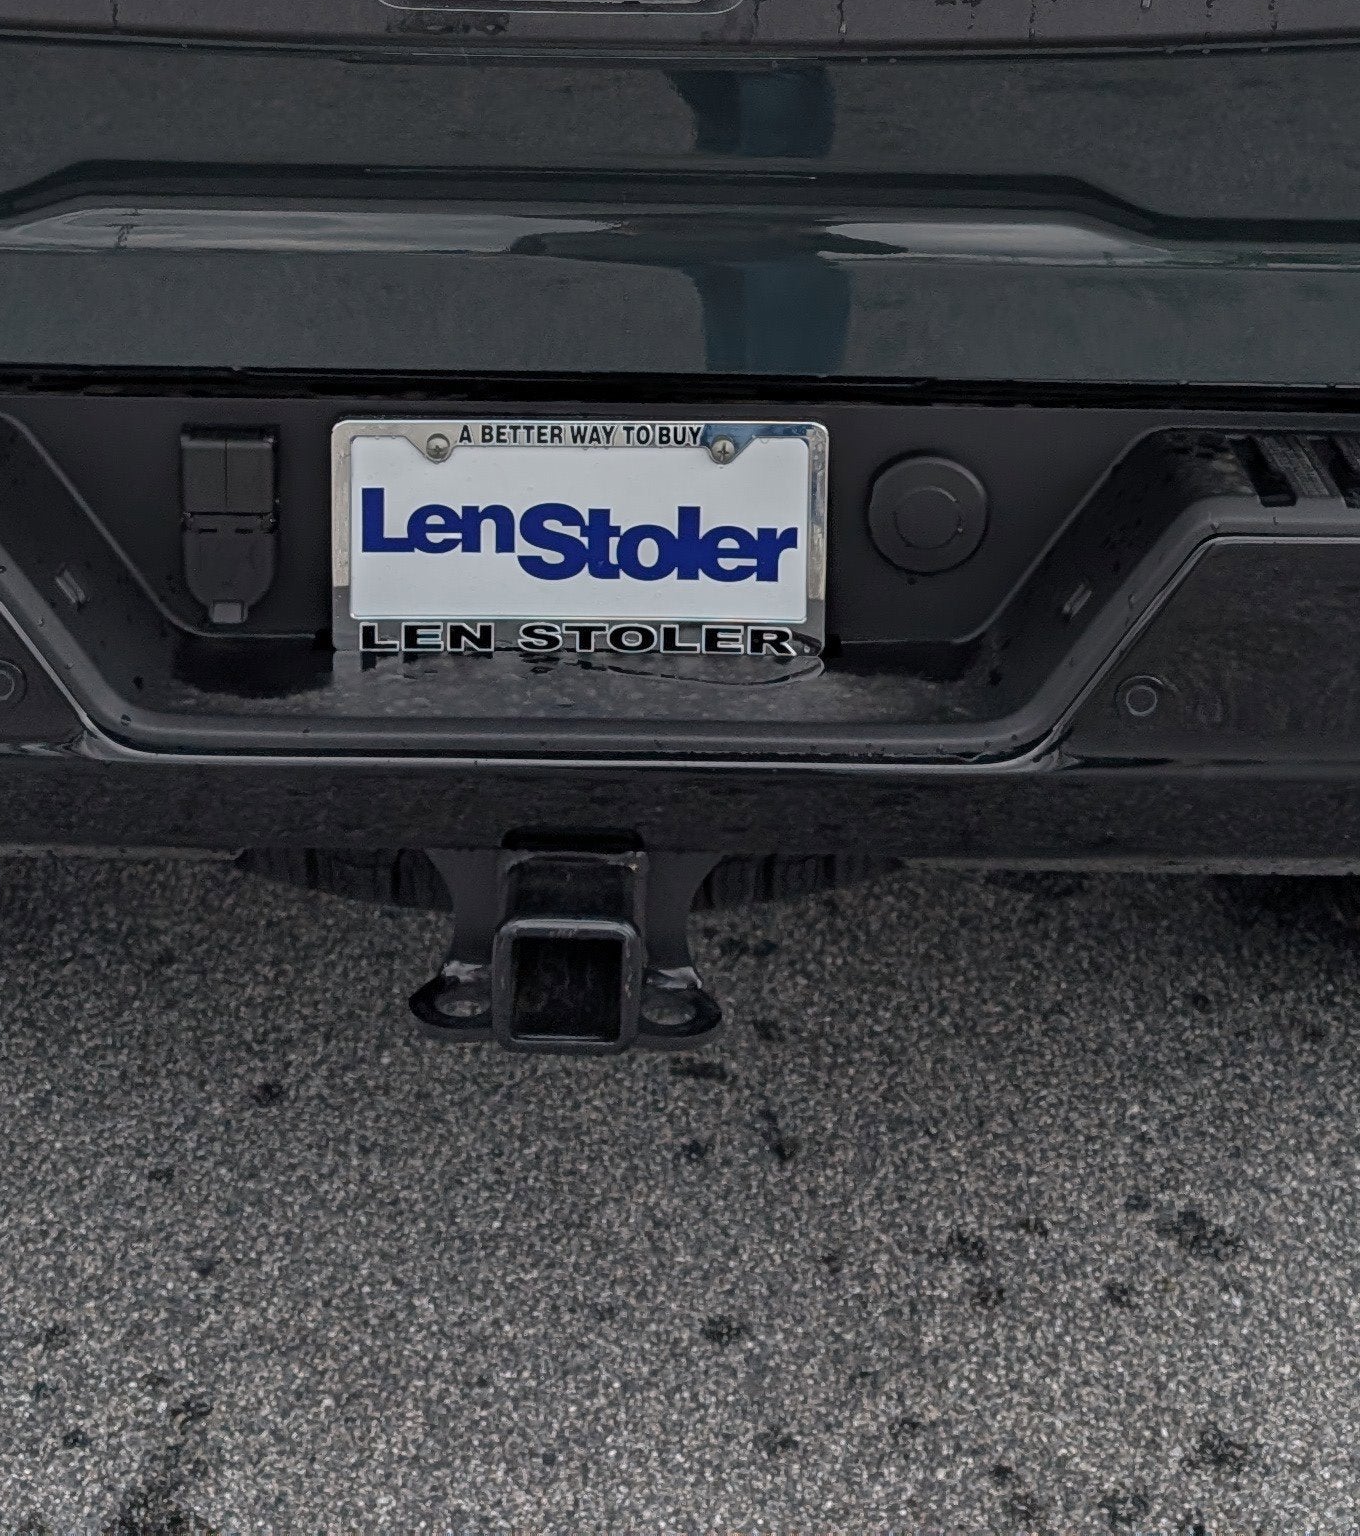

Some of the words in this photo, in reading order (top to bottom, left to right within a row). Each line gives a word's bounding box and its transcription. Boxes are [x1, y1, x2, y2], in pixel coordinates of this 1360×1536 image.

[459, 426, 472, 444] A
[480, 425, 564, 445] BETTER
[570, 425, 616, 444] WAY
[622, 425, 650, 445] TO
[656, 426, 702, 447] BUY
[359, 622, 495, 653] LEN
[517, 623, 797, 656] STOLER
